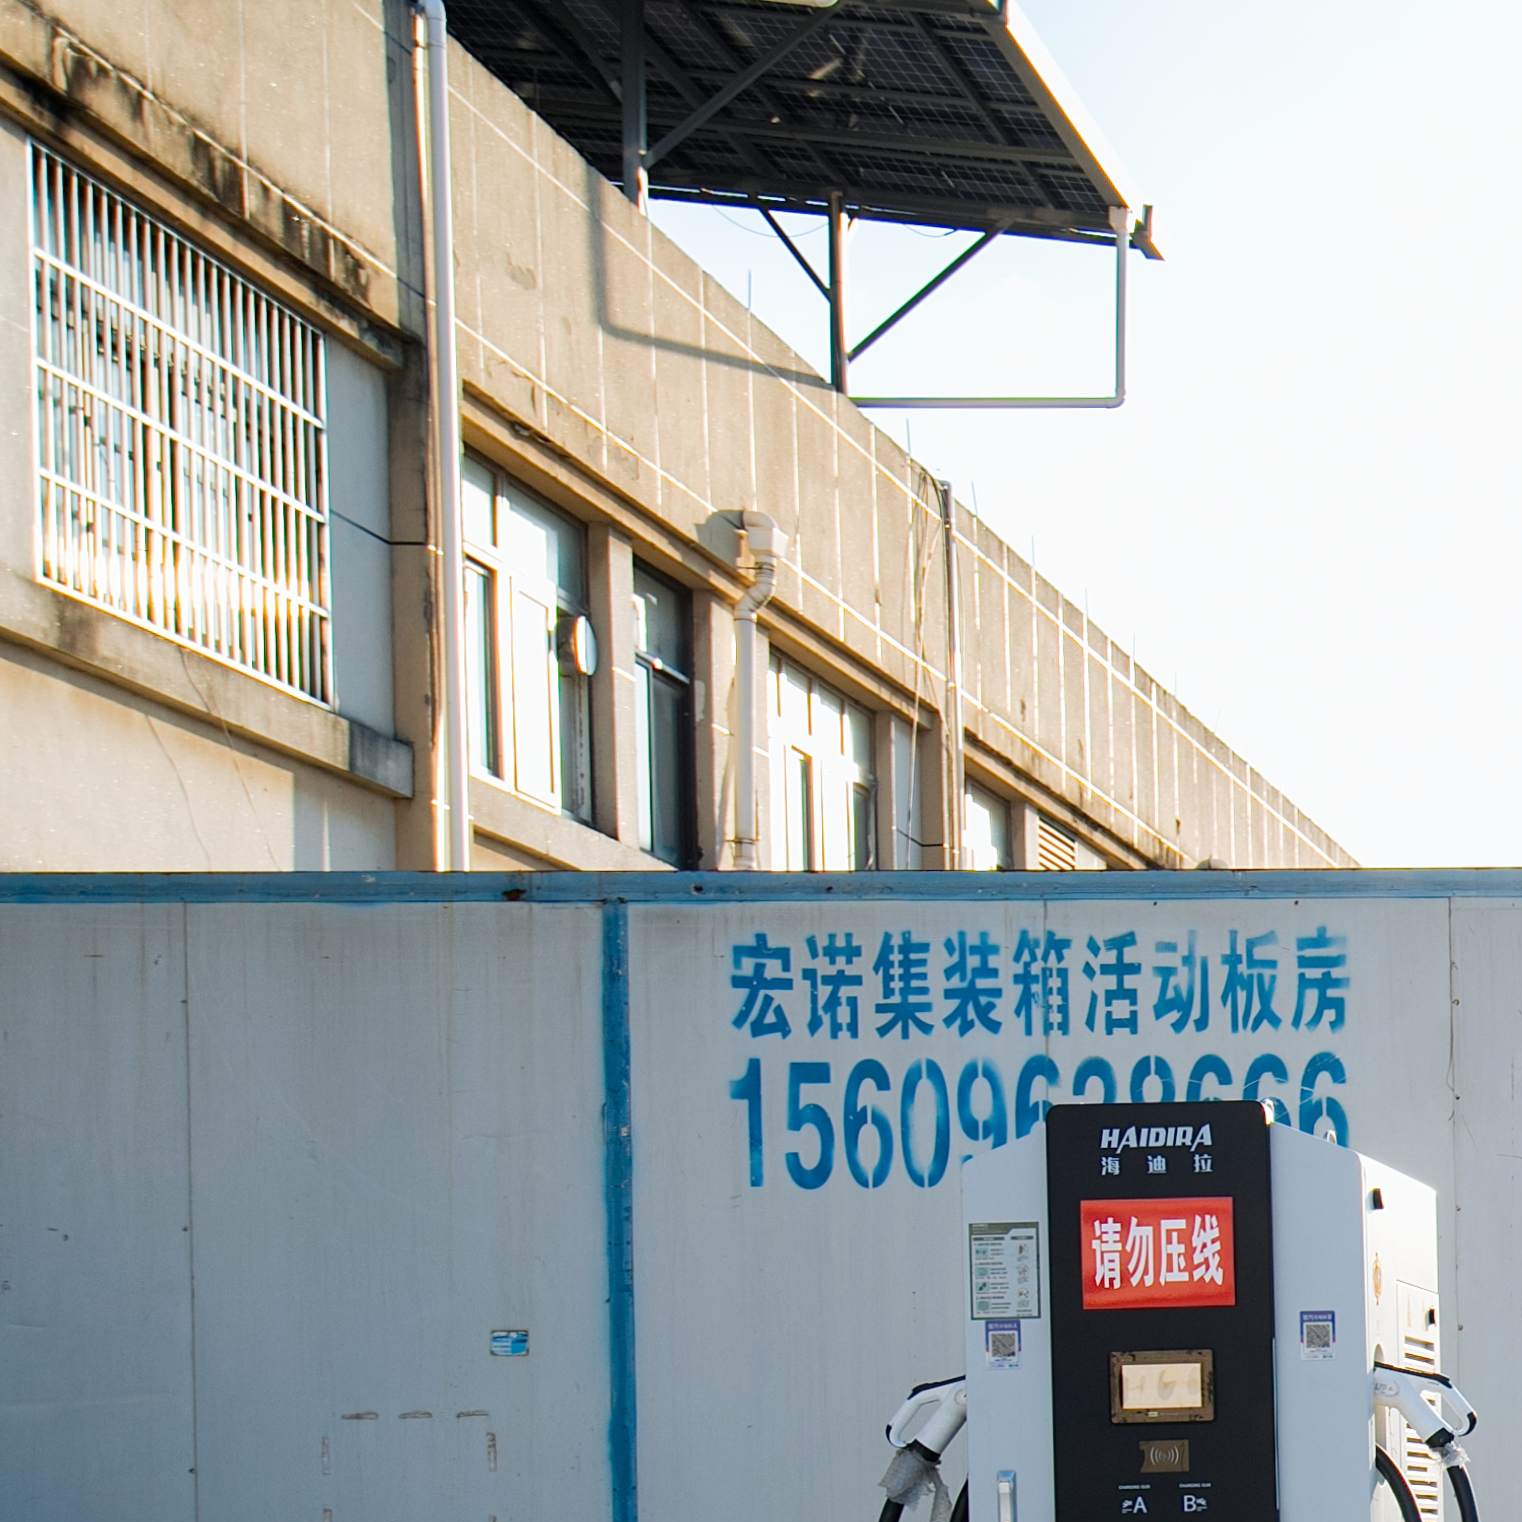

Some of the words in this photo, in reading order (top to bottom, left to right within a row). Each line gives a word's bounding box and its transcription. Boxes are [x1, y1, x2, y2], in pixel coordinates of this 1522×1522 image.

[729, 926, 1351, 1041] 宏诺集装箱活动板房
[1100, 1124, 1213, 1155] HAIDIRA
[1101, 1155, 1213, 1176] 海迪拉
[1092, 1215, 1225, 1291] 请勿压线
[1133, 1496, 1148, 1514] A
[1183, 1495, 1197, 1512] B
